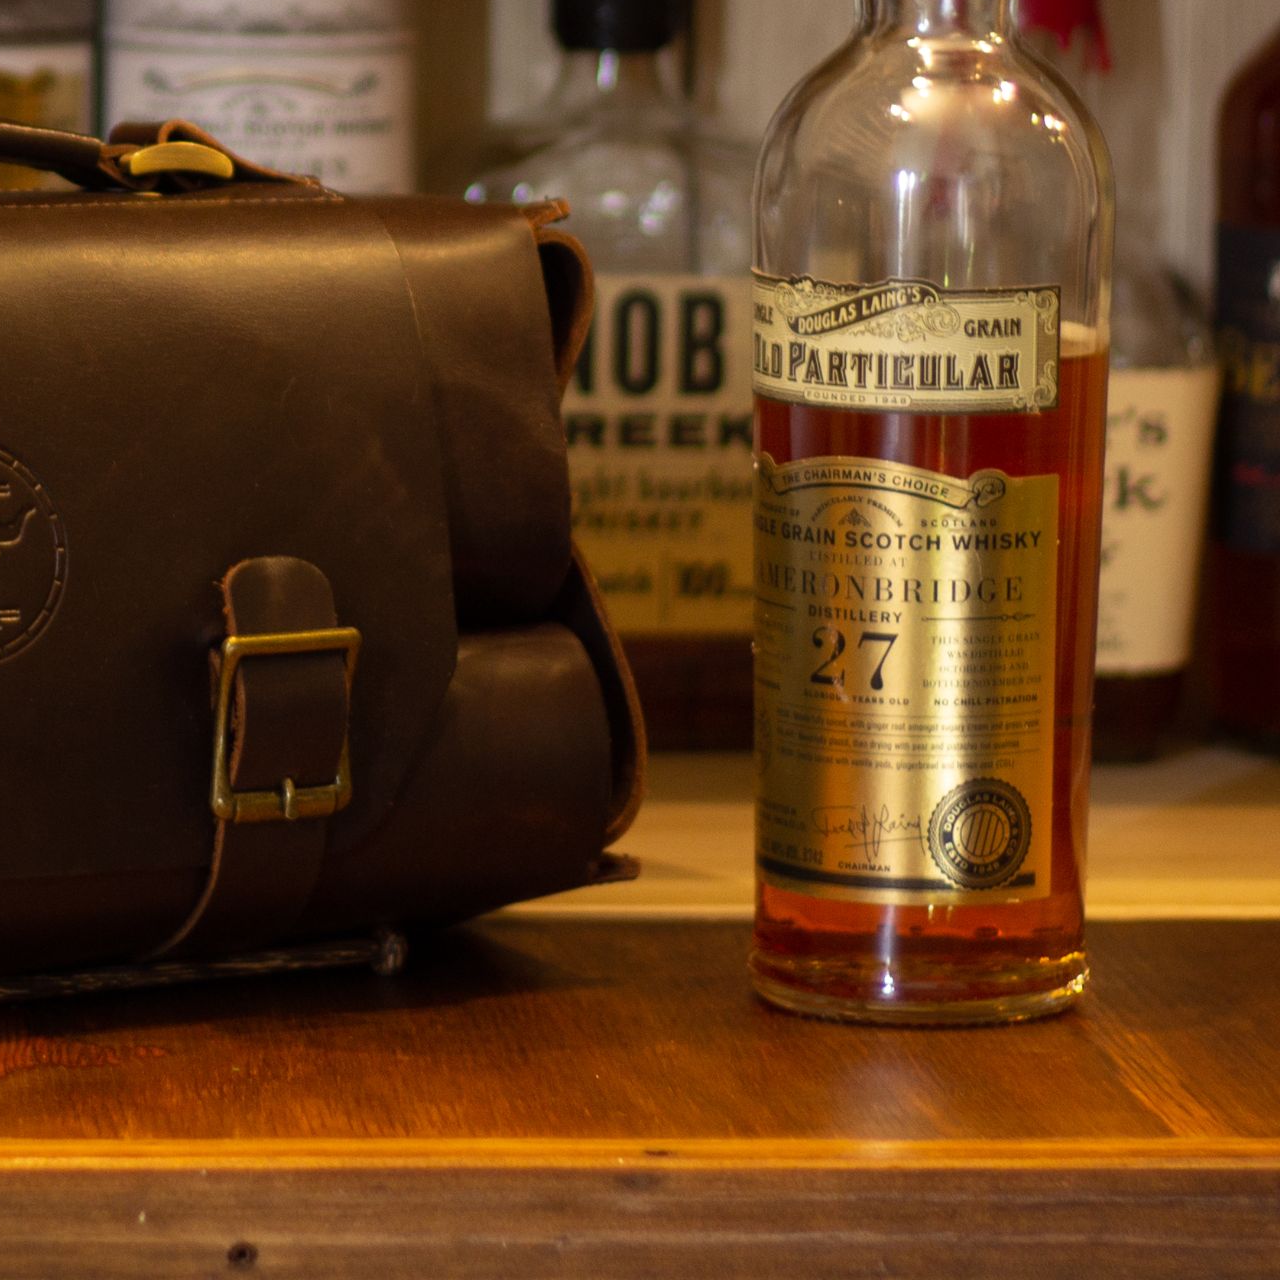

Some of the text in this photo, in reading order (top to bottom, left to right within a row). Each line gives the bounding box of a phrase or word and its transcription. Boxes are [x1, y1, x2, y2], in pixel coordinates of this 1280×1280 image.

[797, 287, 921, 334] DOUGLAS LAING'S
[964, 317, 1022, 338] GRAIN
[786, 339, 1021, 391] PARTICULAR
[806, 390, 866, 403] FOUNDED
[804, 469, 887, 484] CHAIRMAN'S
[892, 475, 950, 498] CHOICE
[920, 518, 998, 528] SCOTLAND
[781, 521, 836, 545] GRAIN
[845, 531, 941, 551] SCOTCH
[952, 531, 1042, 551] WHISKY
[808, 604, 903, 624] DISTILLERY
[809, 625, 899, 691] 27
[888, 697, 910, 706] OLD
[934, 698, 949, 706] NO
[837, 860, 891, 873] CHAIRMAN
